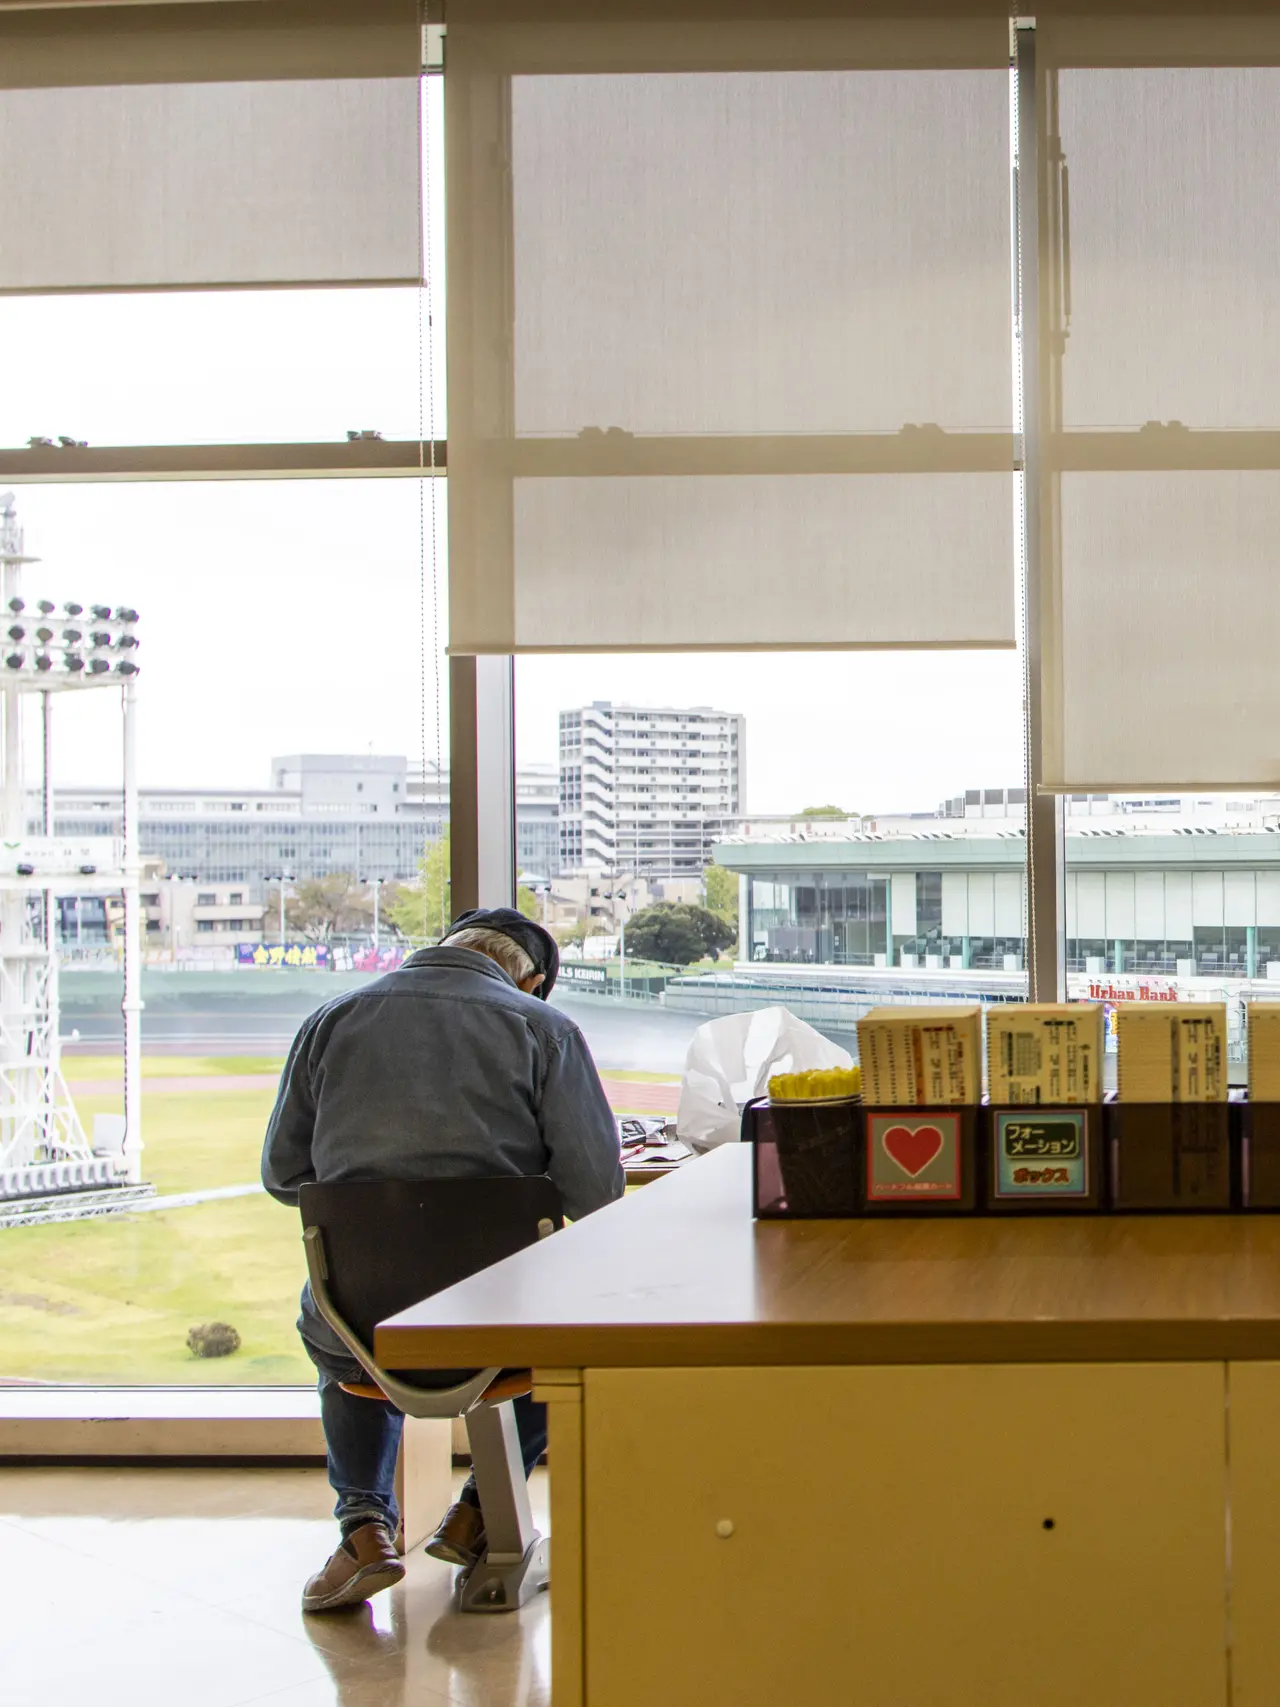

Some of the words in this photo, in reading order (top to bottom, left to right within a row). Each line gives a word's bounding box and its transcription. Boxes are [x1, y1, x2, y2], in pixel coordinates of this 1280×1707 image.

[1089, 984, 1135, 1000] Urban
[1139, 986, 1178, 1001] Bank
[1008, 1125, 1045, 1139] フォー
[1012, 1139, 1074, 1154] メーション
